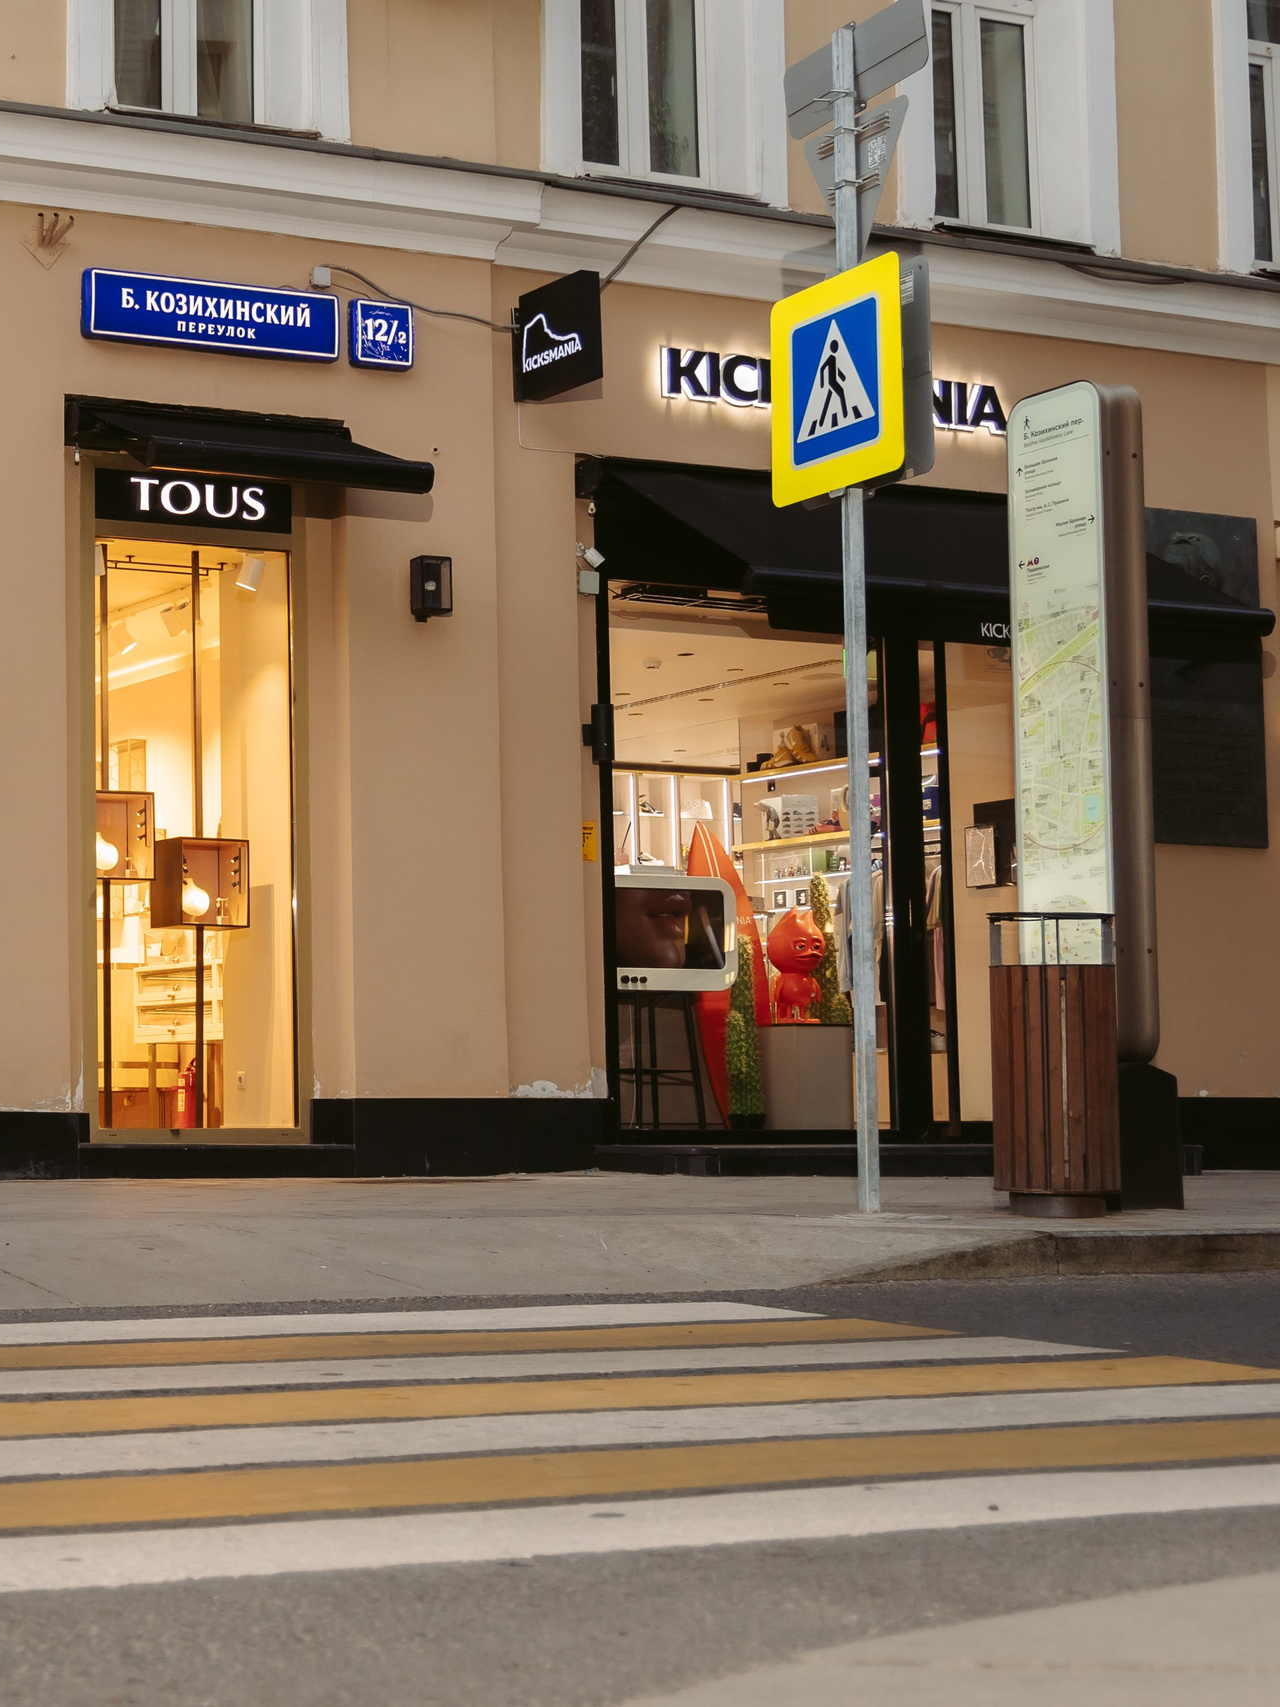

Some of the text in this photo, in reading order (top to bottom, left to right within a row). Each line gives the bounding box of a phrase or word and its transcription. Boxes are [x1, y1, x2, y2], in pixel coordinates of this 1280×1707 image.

[121, 287, 312, 328] Б. КОЗИХИНСКИЙ
[177, 320, 257, 340] ПЕРЕУЛОК
[364, 318, 407, 345] 12/2
[523, 340, 583, 374] KICKSMANIA
[130, 477, 266, 521] TOUS
